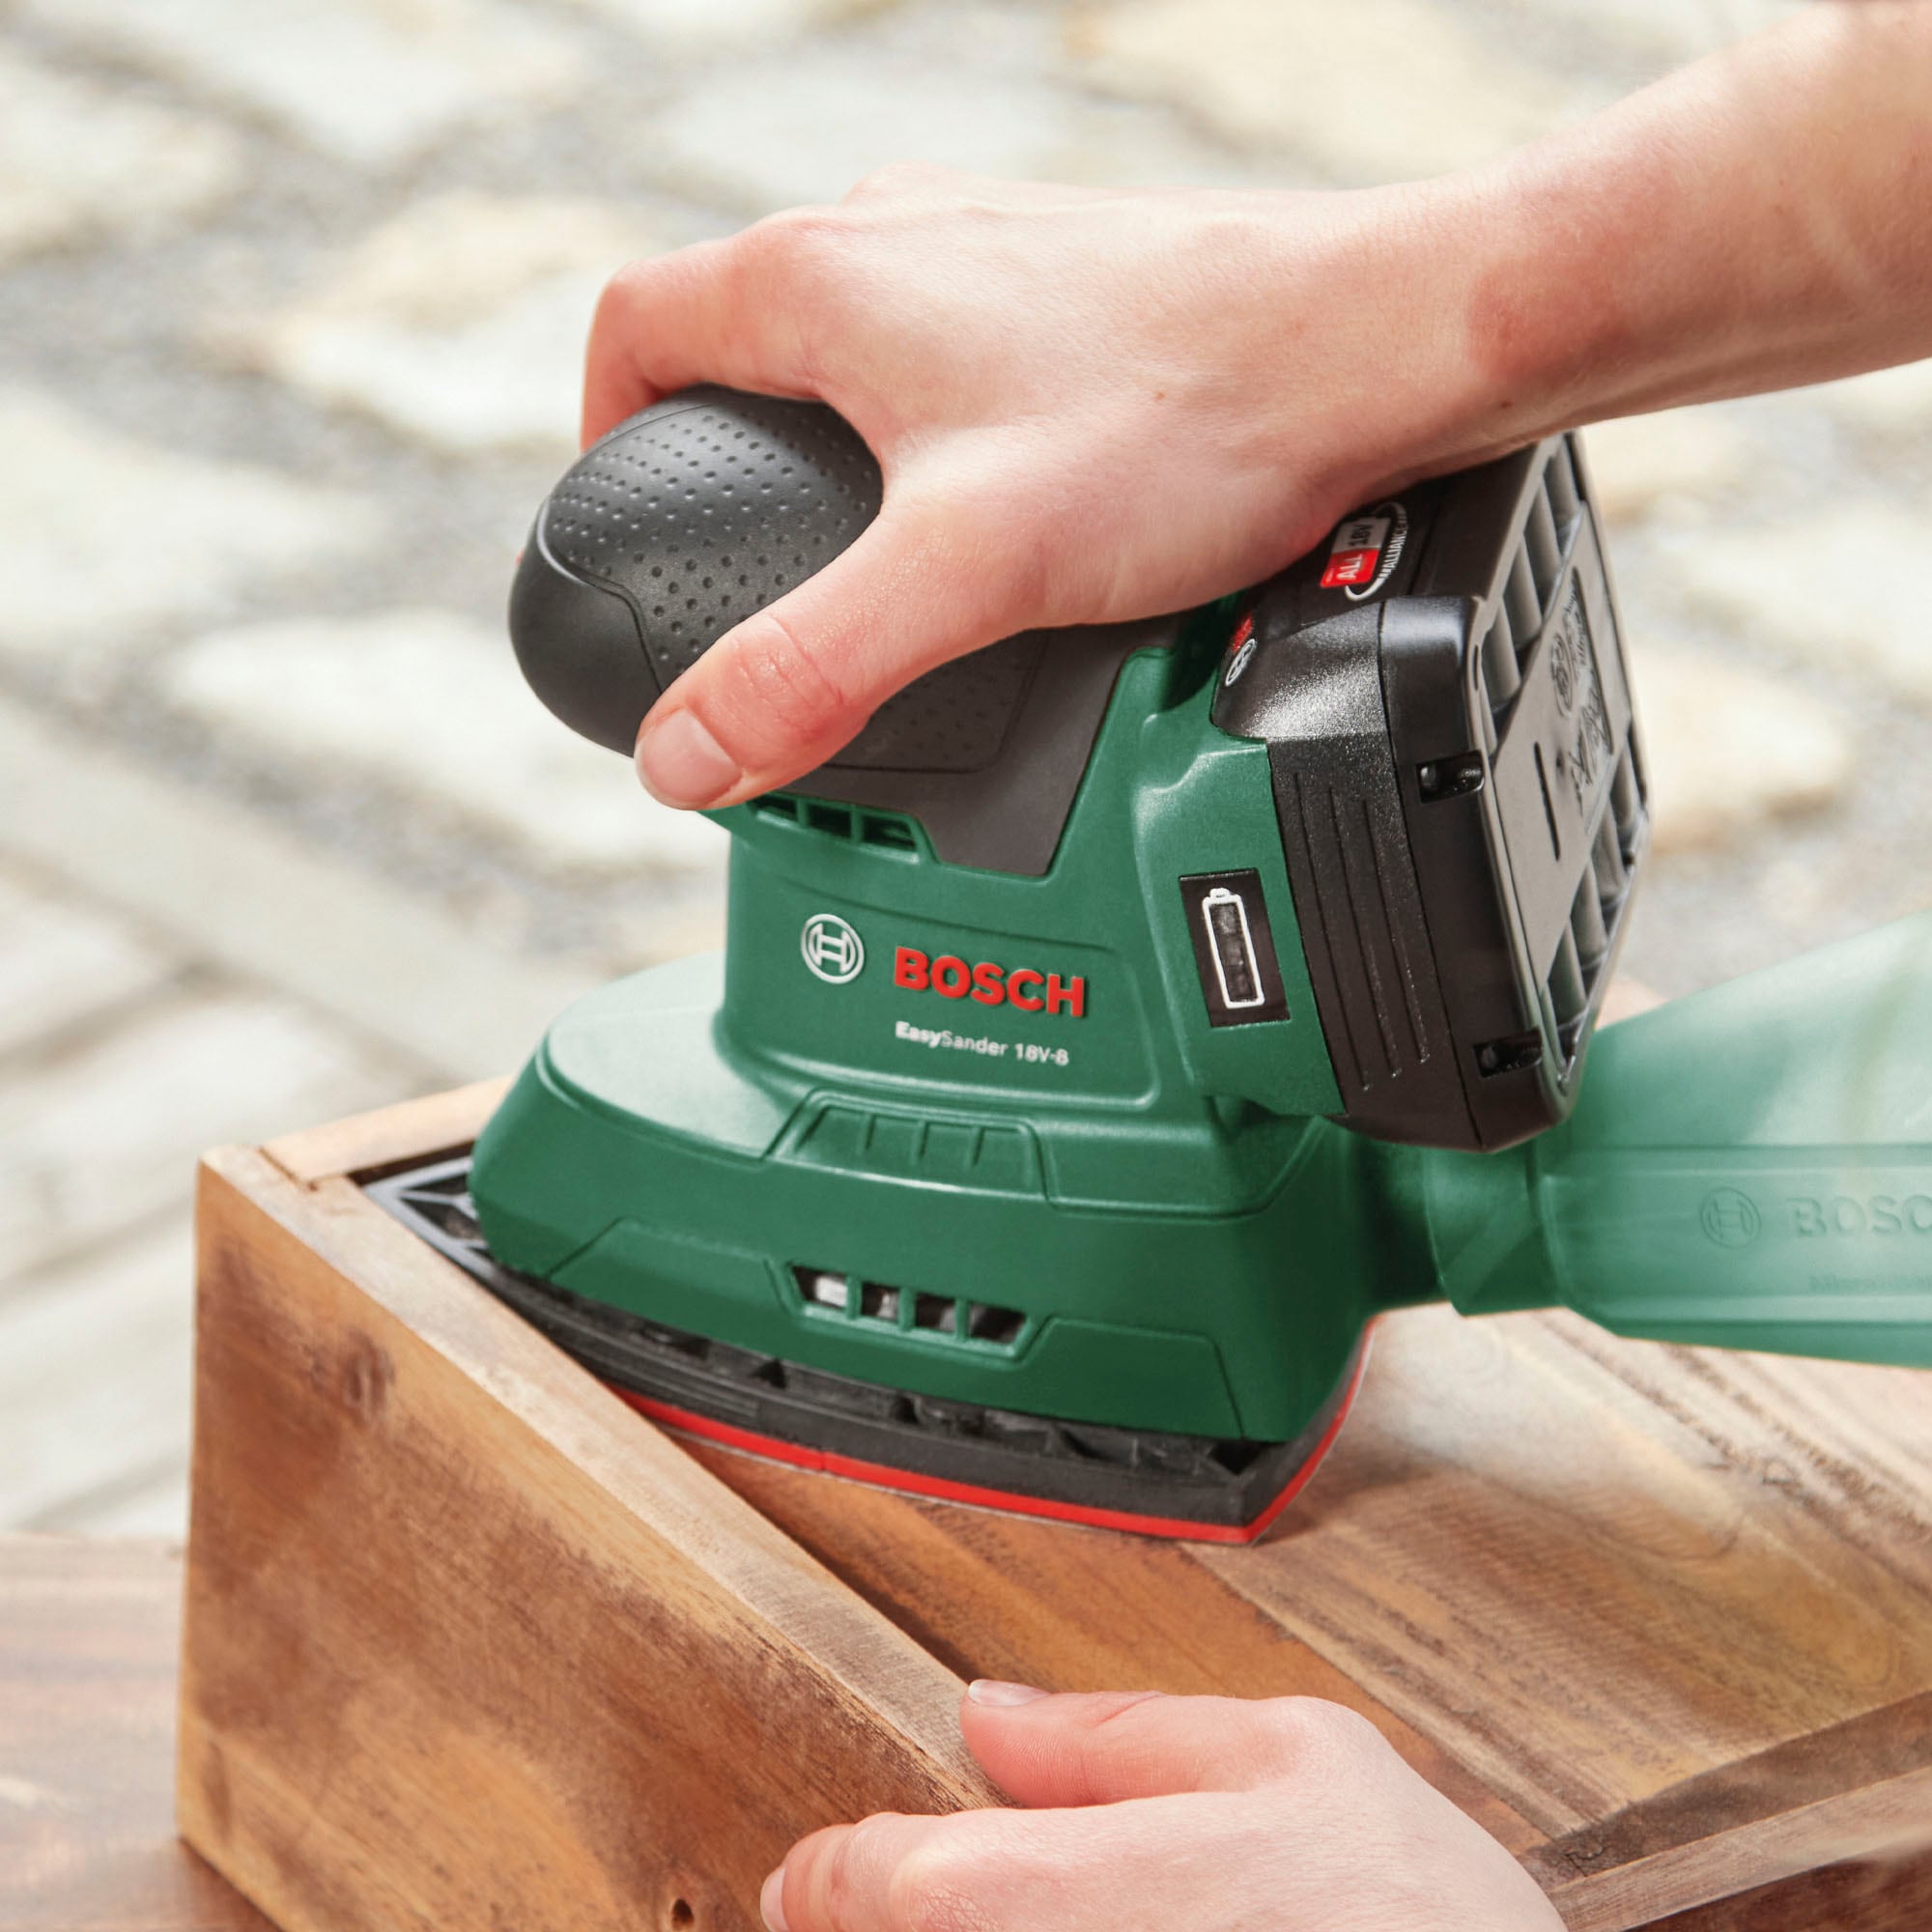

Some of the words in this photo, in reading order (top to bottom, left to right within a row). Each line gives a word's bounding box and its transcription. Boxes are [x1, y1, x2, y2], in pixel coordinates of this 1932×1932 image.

[1349, 524, 1373, 547] 18V
[1336, 553, 1363, 581] ALL
[894, 946, 1086, 1017] BOSCH
[895, 1020, 1008, 1056] EasySander
[1014, 1043, 1069, 1066] 18V-8
